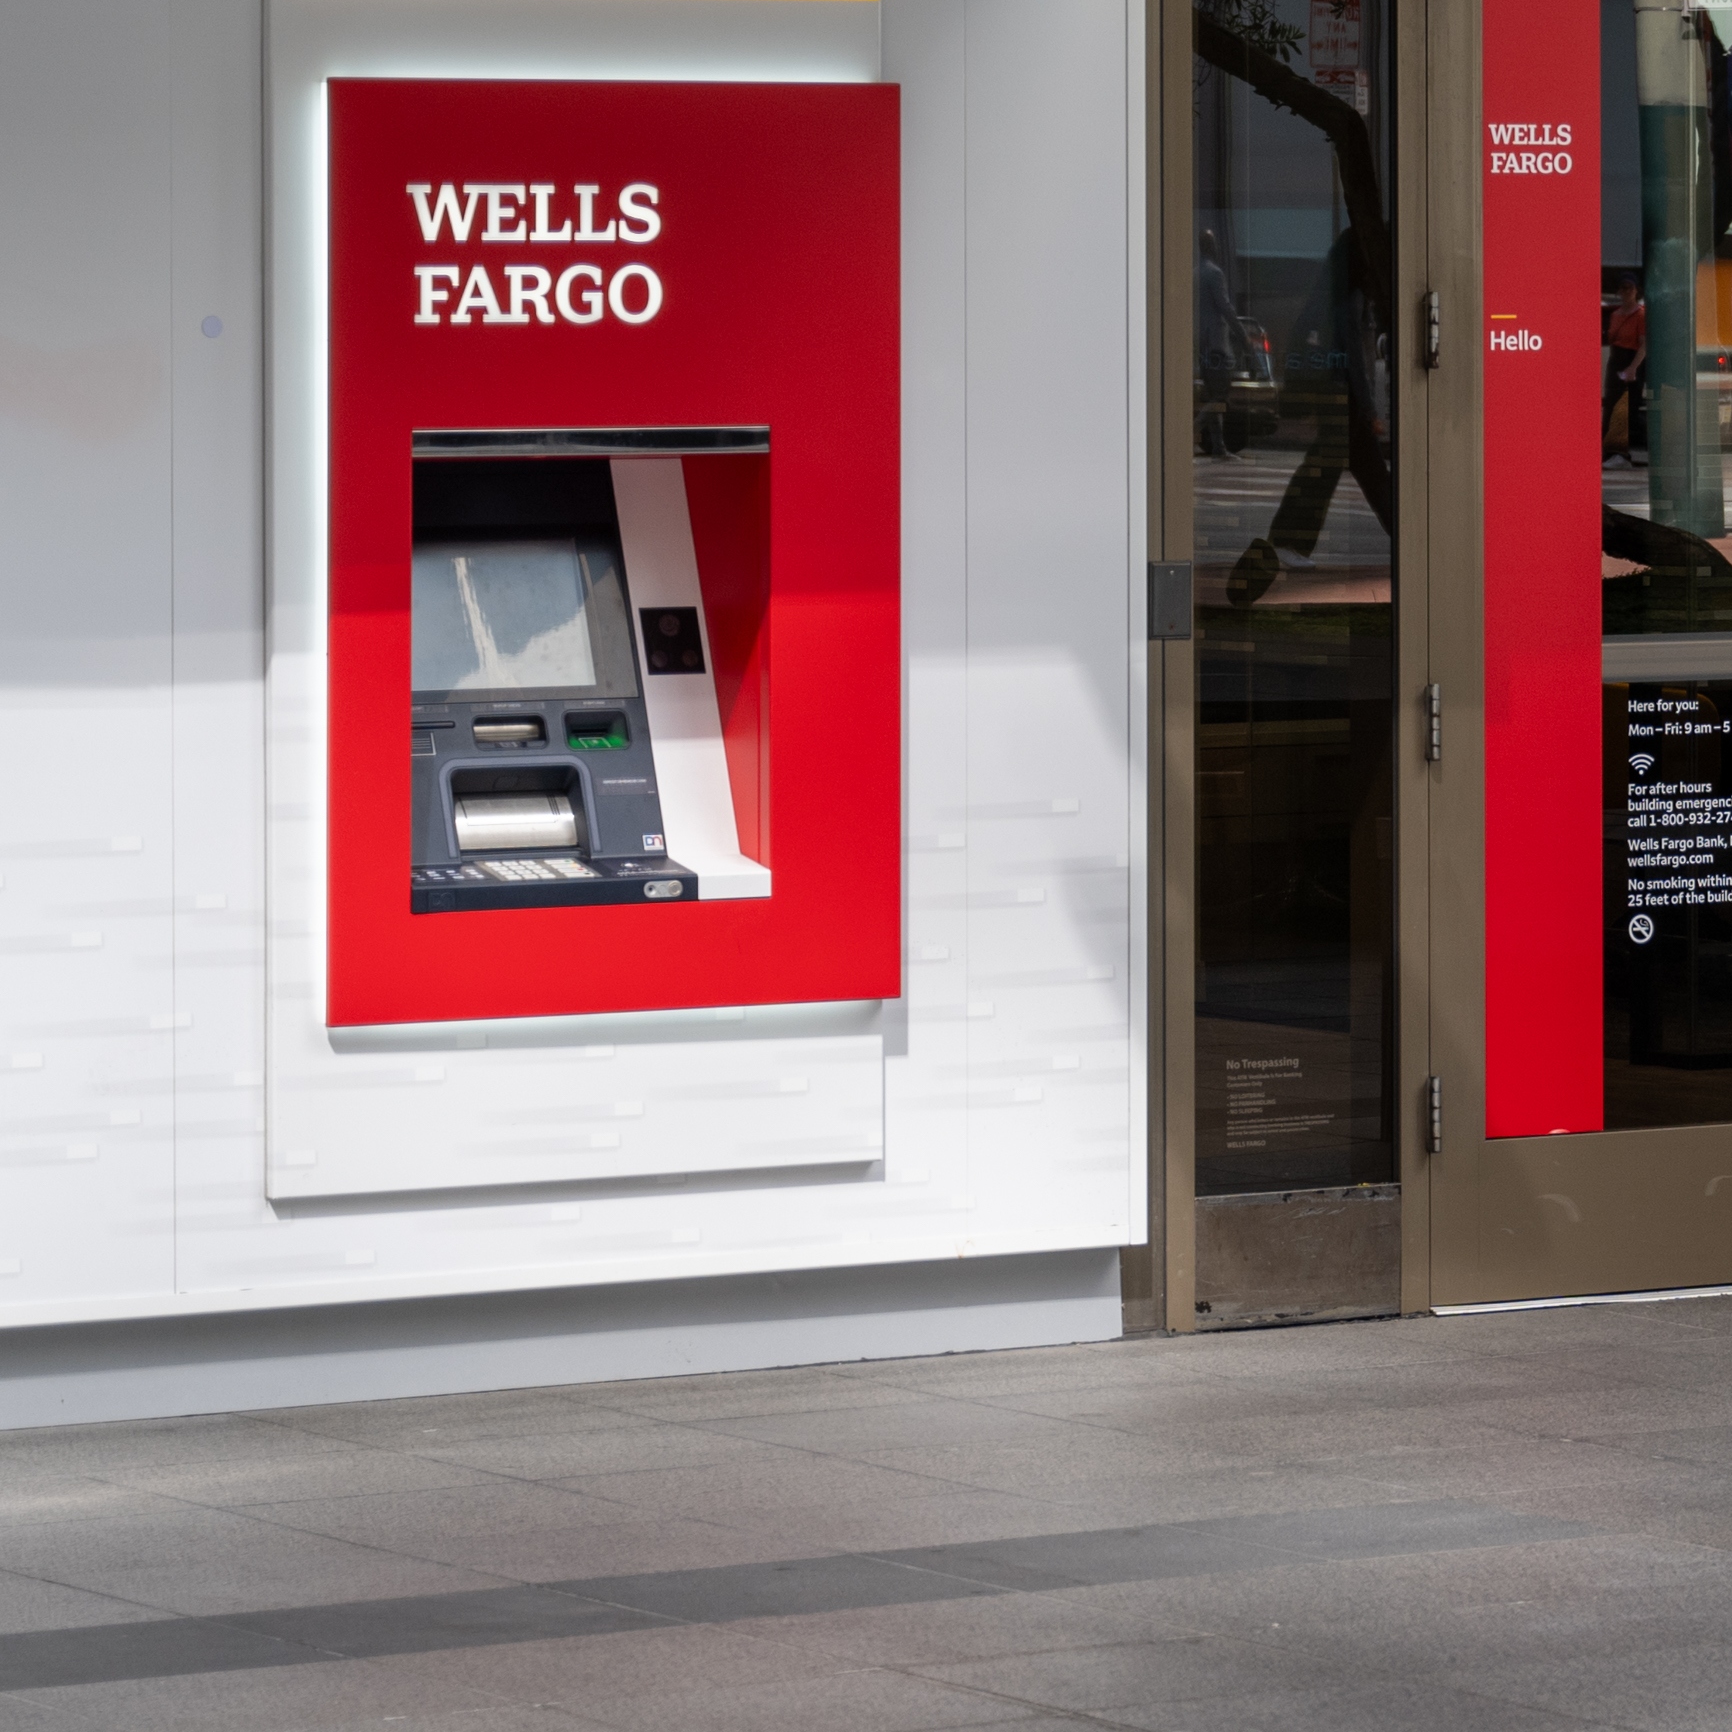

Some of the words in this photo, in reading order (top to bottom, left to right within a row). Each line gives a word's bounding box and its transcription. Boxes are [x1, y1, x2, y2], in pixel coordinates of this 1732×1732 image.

[1489, 123, 1572, 146] WELLS
[1490, 152, 1573, 175] FARGO
[407, 182, 662, 243] WELLS
[413, 265, 663, 325] FARGO
[1489, 330, 1542, 352] Hello
[1628, 700, 1655, 713] Here
[1656, 698, 1674, 712] for
[1675, 701, 1699, 714] you:
[1628, 723, 1654, 737] Mon
[1664, 722, 1683, 735] Fri:
[1684, 722, 1692, 734] 9
[1694, 723, 1712, 734] am
[1722, 720, 1730, 733] 5
[1628, 783, 1647, 796] For
[1649, 782, 1678, 795] after
[1680, 781, 1712, 794] hours
[1628, 798, 1673, 812] building
[1627, 814, 1647, 827] call
[1627, 838, 1659, 851] Wells
[1661, 837, 1694, 852] Fargo
[1696, 835, 1727, 849] Bank,
[1627, 853, 1714, 868] wellsfargo.com
[1628, 879, 1644, 891] No
[1646, 876, 1695, 891] smoking
[1697, 874, 1732, 887] within
[1628, 894, 1643, 907] 25
[1645, 893, 1669, 906] feet
[1671, 891, 1685, 905] of
[1686, 891, 1705, 904] the
[1226, 1060, 1240, 1069] No
[1241, 1057, 1299, 1070] Trespassing
